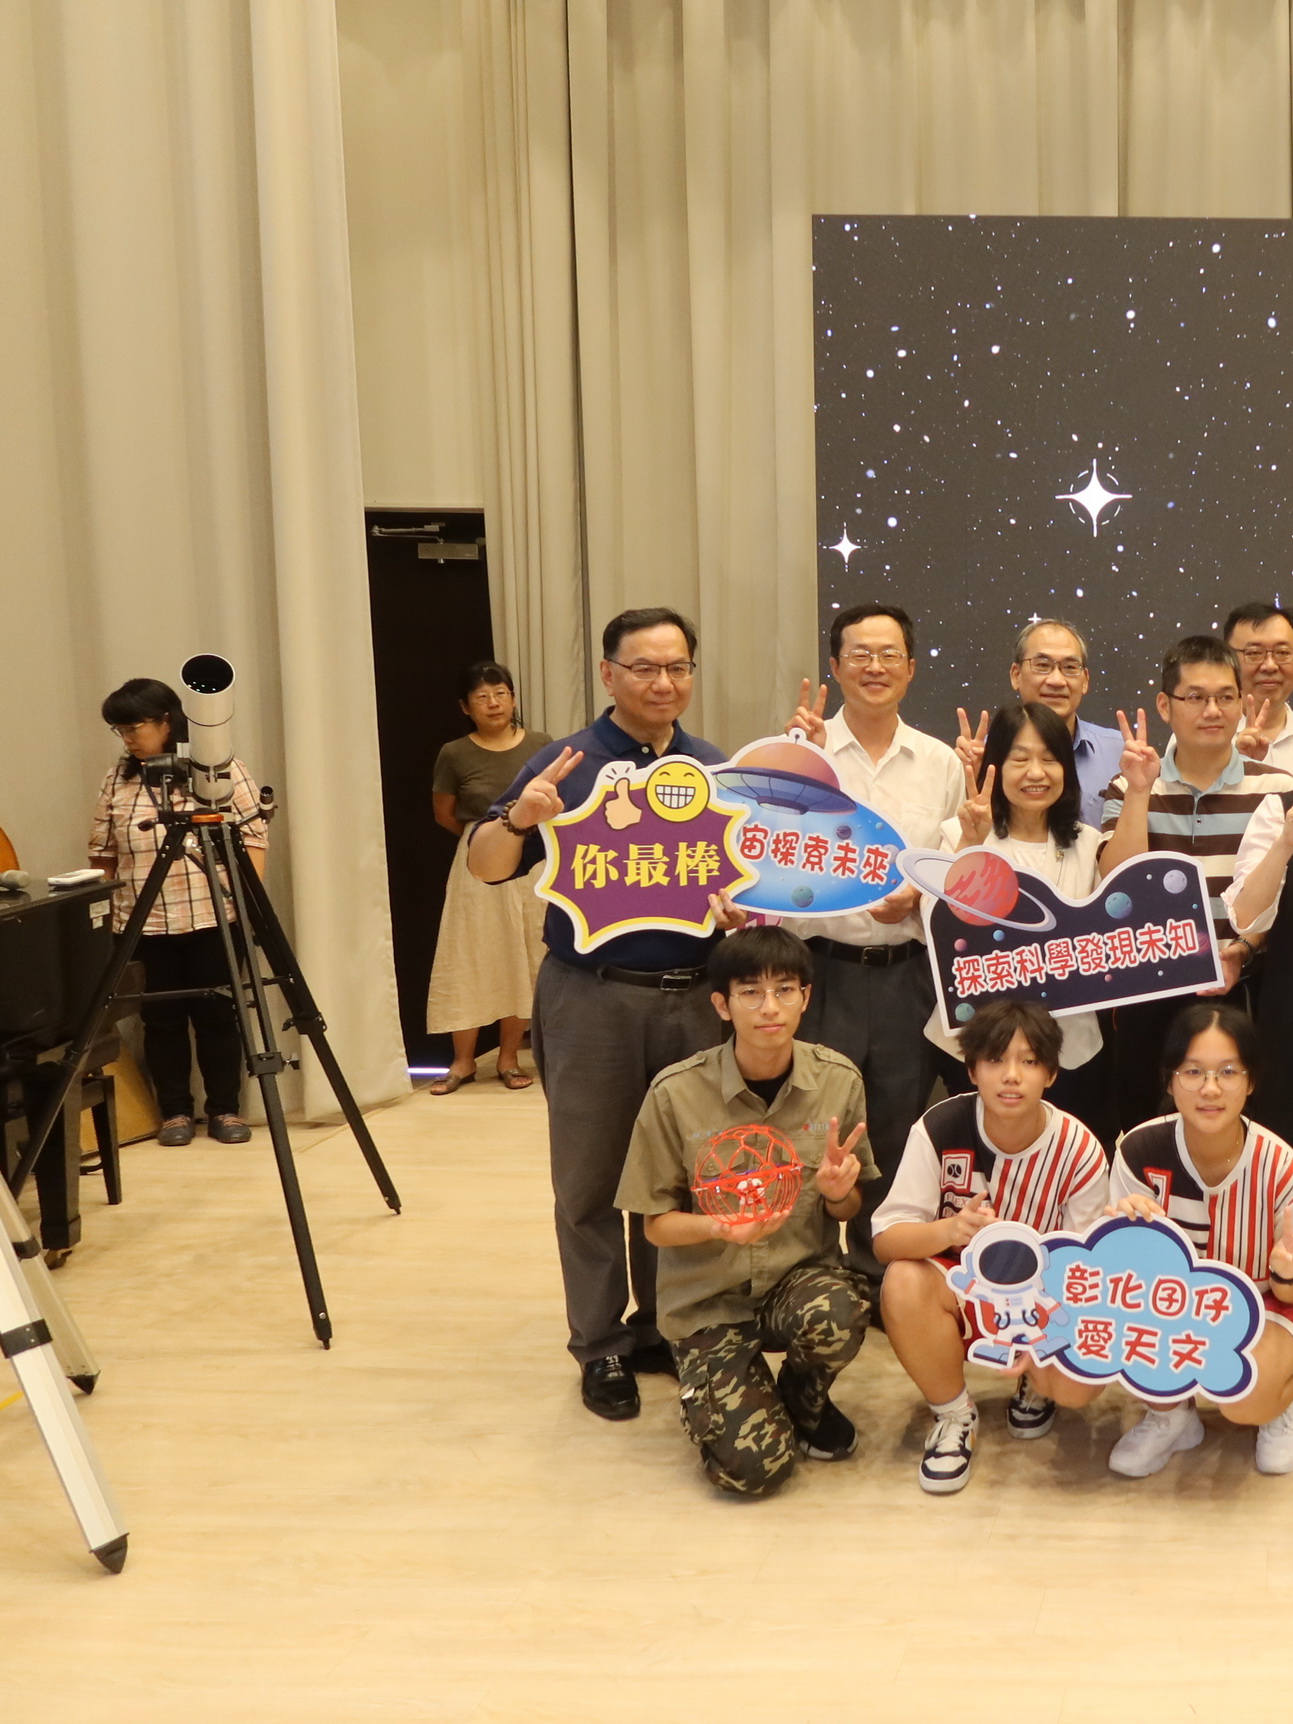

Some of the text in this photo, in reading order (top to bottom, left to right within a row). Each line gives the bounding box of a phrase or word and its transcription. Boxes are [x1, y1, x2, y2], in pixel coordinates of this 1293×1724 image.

[571, 842, 721, 889] 你最棒
[740, 824, 892, 885] 宙探索未來
[953, 919, 1200, 998] 探索科學發現未知
[1063, 1265, 1230, 1323] 彰化囝仔
[1076, 1318, 1208, 1371] 愛天文
